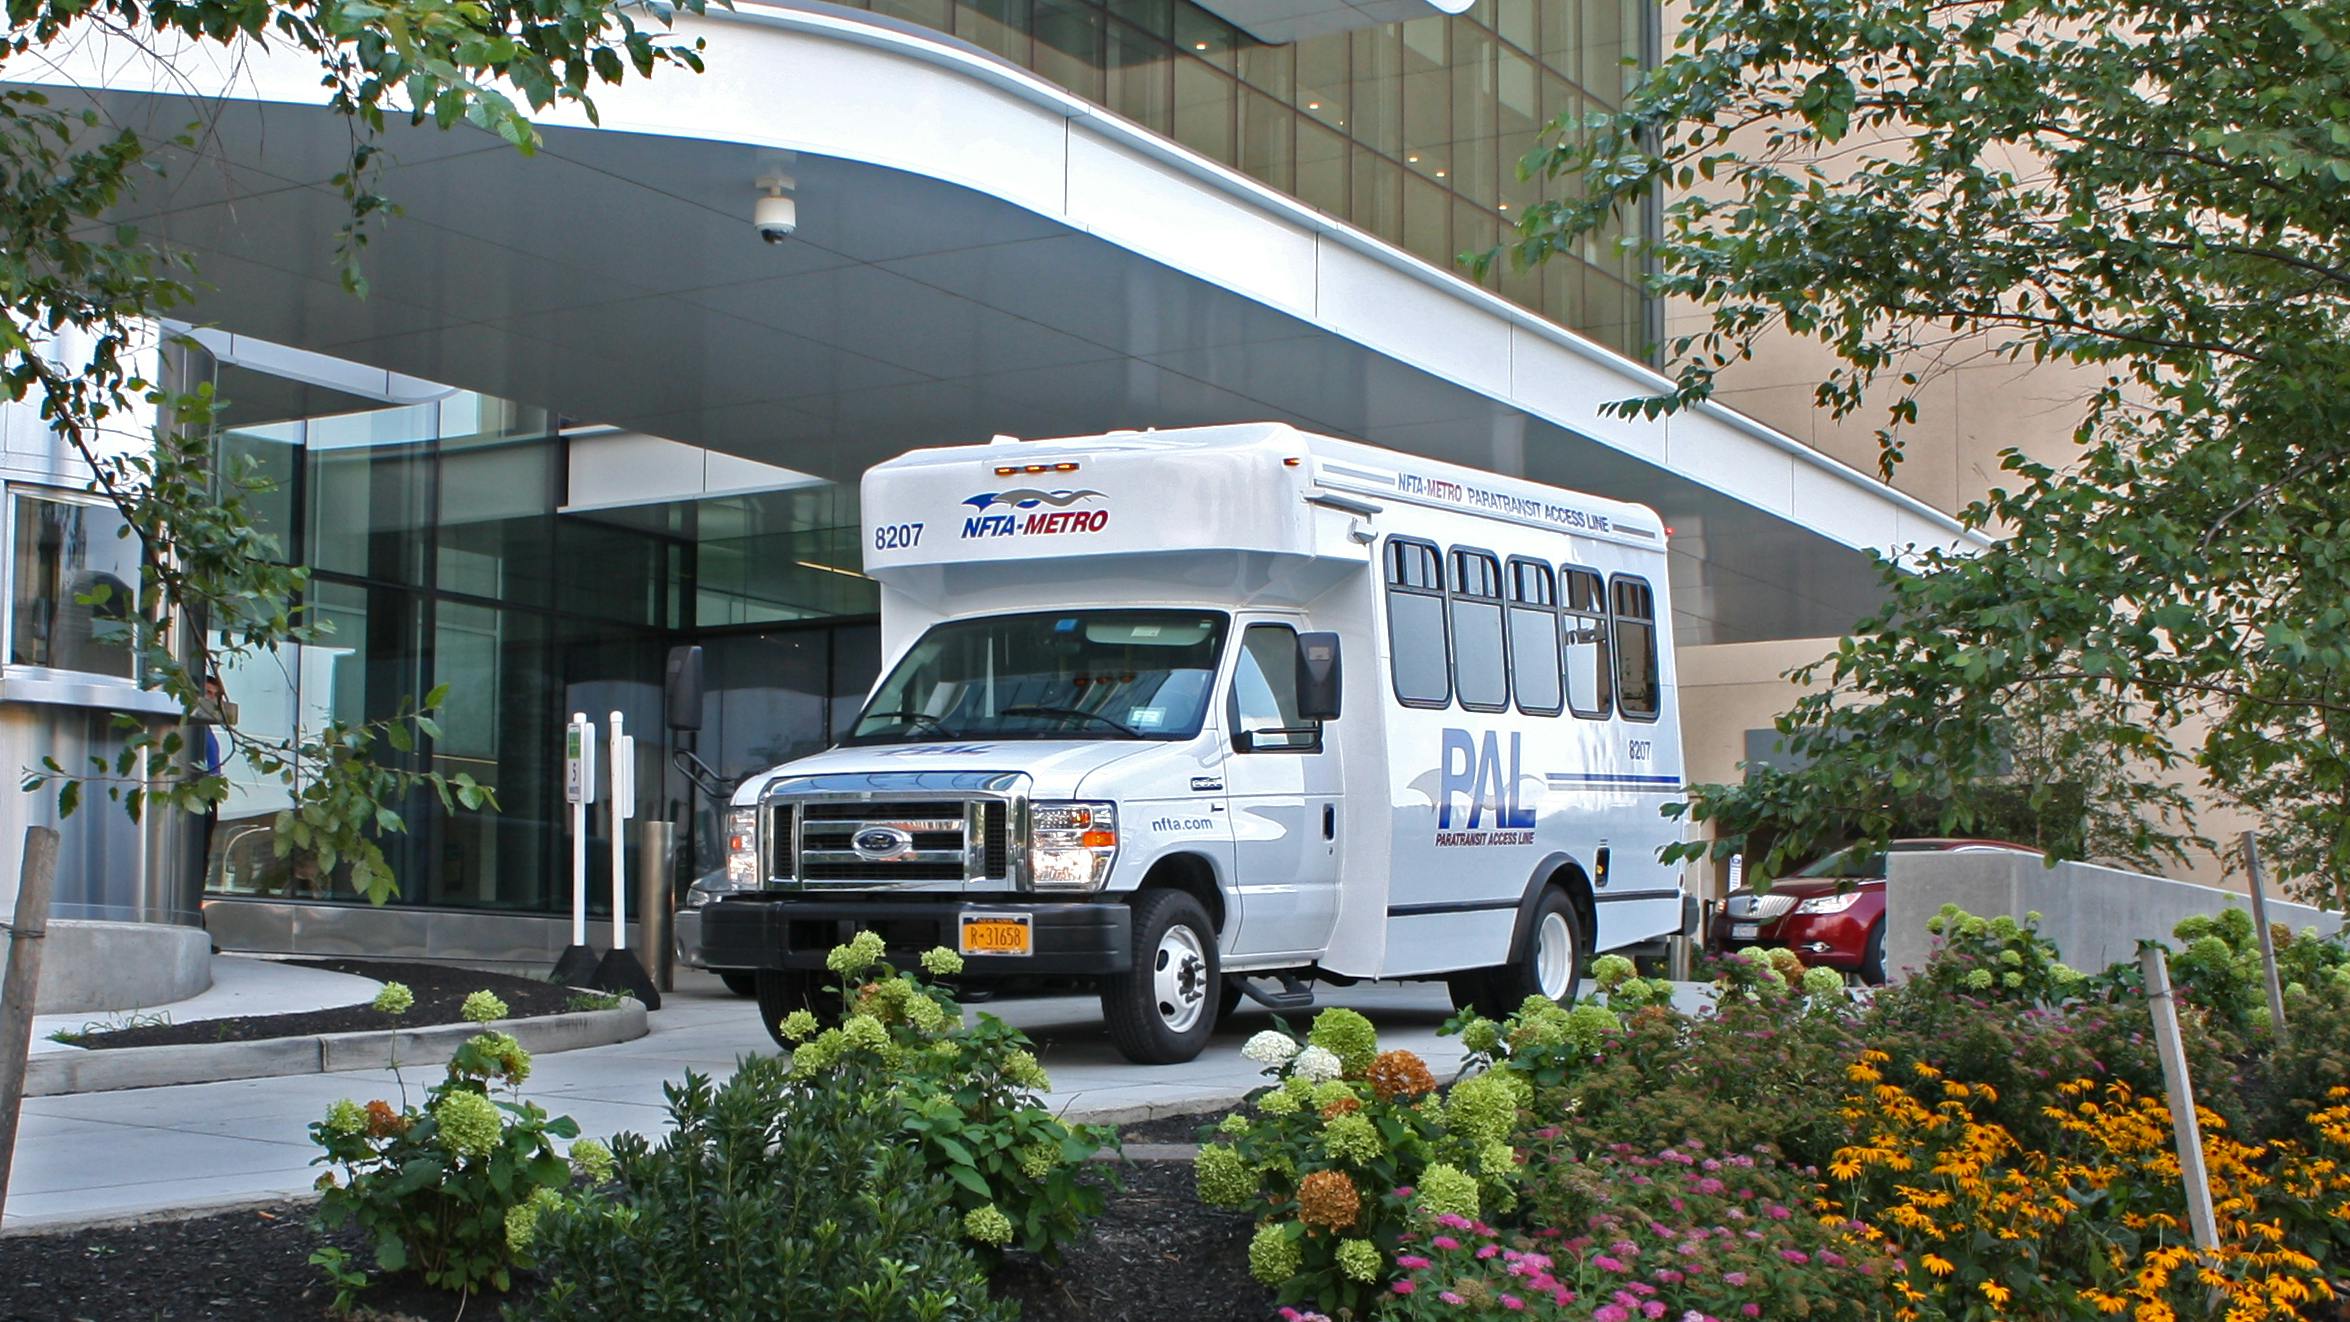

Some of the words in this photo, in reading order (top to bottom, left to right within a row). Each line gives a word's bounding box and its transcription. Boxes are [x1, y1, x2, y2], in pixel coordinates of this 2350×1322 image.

[1398, 472, 1462, 502] NFTA-METRO
[1467, 487, 1541, 519] PARATRANSIT
[1544, 504, 1585, 528] ACCESS
[1586, 513, 1611, 533] LINE
[875, 523, 924, 550] 8207
[961, 510, 1108, 539] NFTA-METRO
[1629, 739, 1651, 760] 8207
[1438, 728, 1536, 829] PAL
[1152, 817, 1213, 832] nfta.com
[1435, 831, 1487, 847] PARATRANSIT
[1487, 831, 1518, 846] ACCESS
[1518, 831, 1535, 845] LINE
